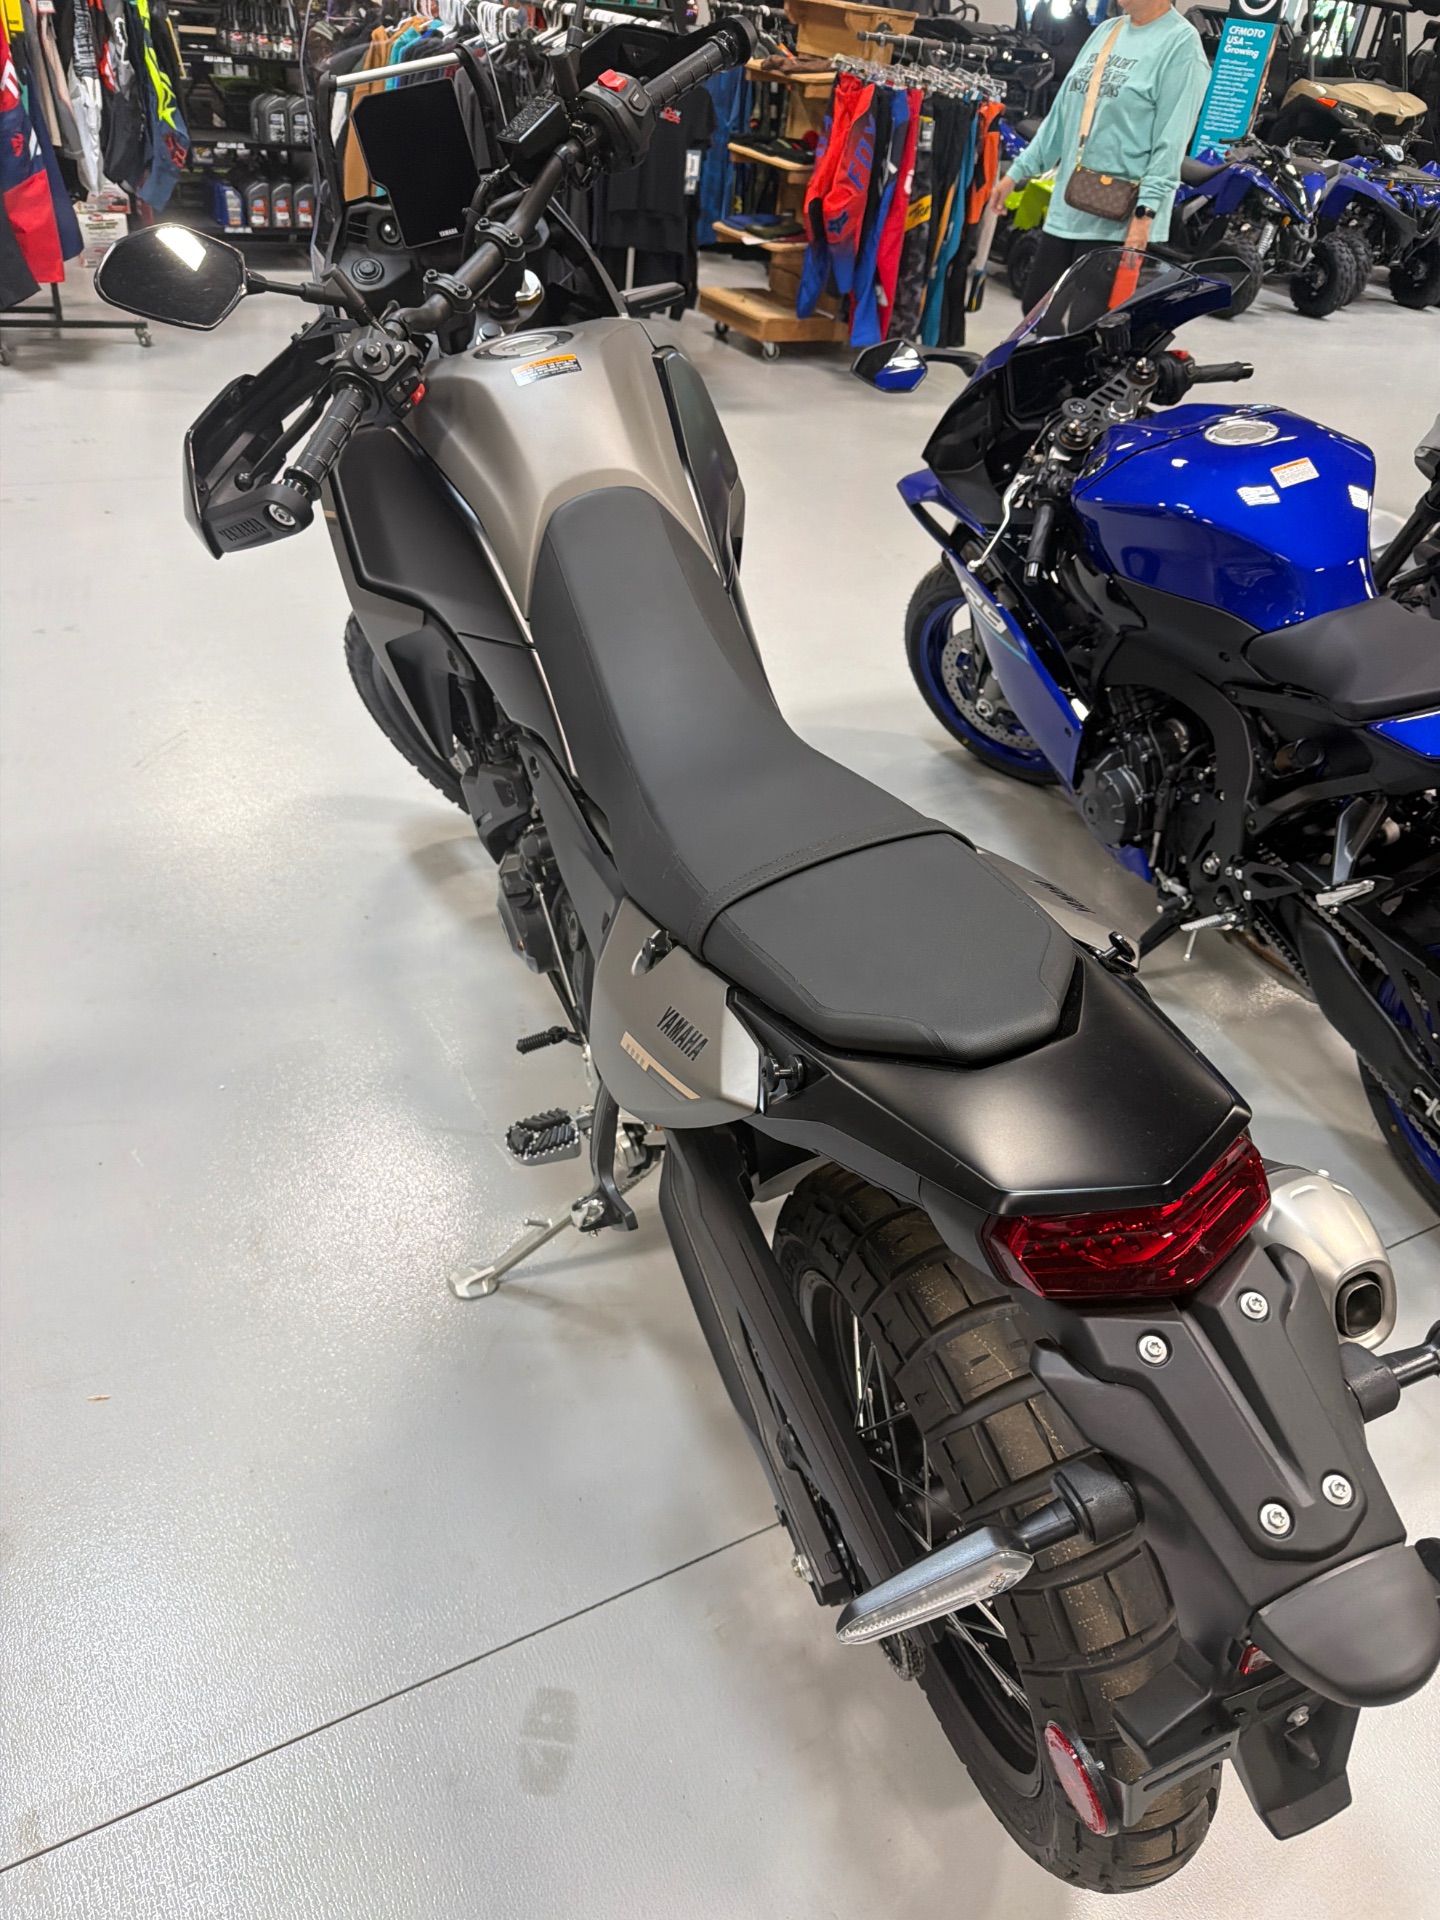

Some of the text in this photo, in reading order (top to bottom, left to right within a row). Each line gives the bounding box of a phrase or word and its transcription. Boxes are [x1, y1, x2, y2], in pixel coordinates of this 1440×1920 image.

[1229, 25, 1266, 38] CFMOTO
[1226, 35, 1244, 45] USA
[1223, 44, 1260, 59] Growing
[439, 227, 459, 237] YAMAHA
[217, 517, 267, 542] YAMAHA
[656, 1005, 710, 1062] YAMAHA
